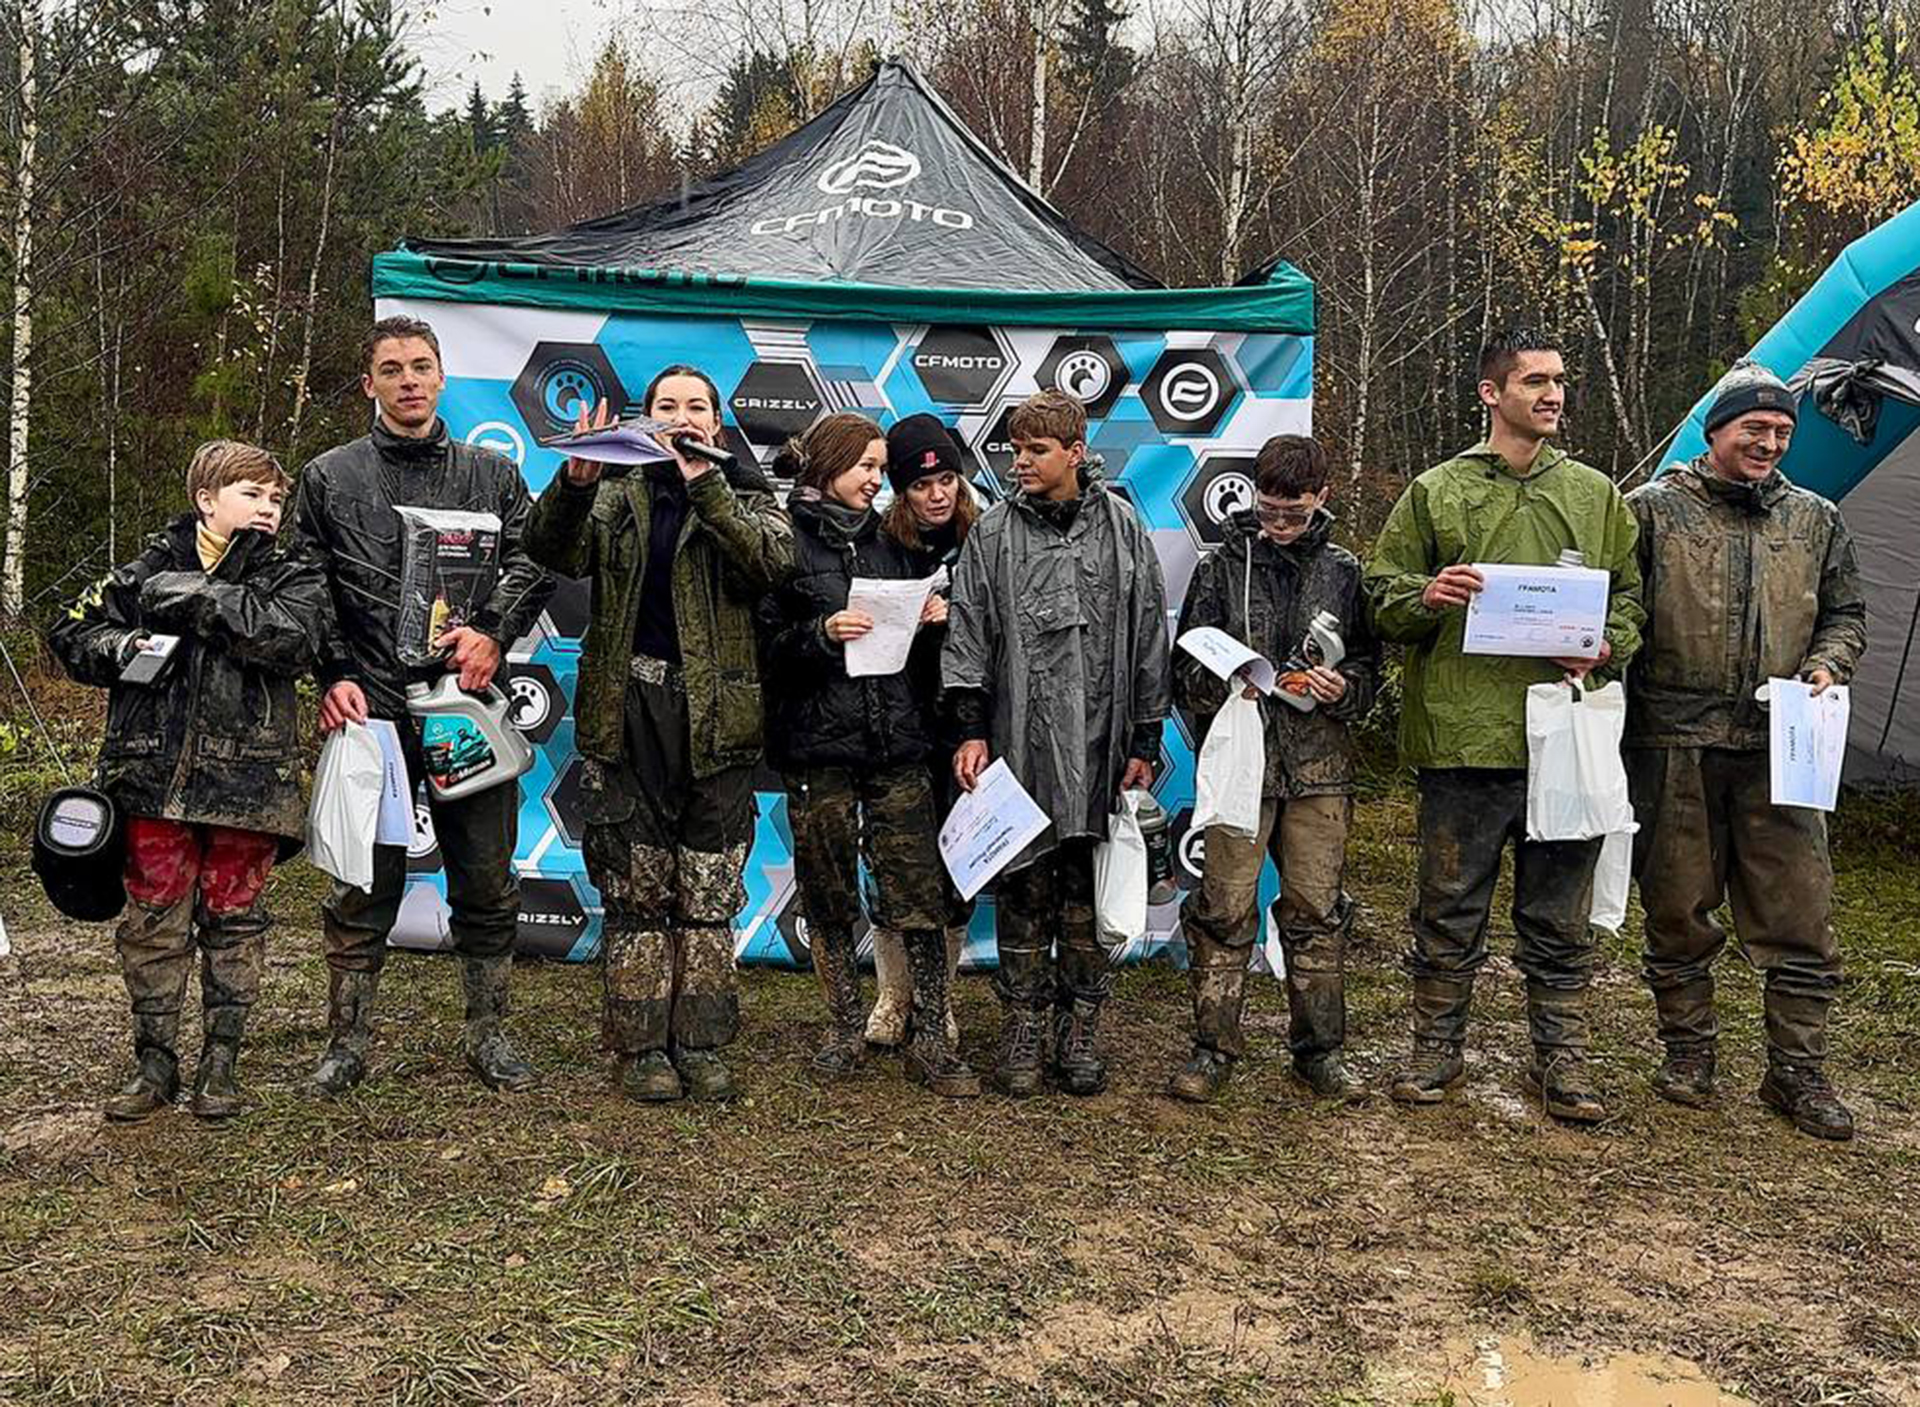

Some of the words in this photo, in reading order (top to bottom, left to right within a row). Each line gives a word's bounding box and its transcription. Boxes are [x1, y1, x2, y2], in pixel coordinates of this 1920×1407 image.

[751, 198, 973, 235] CFMOTO
[914, 354, 1001, 369] CFMOTO
[734, 397, 818, 411] GRIZZLY
[1517, 584, 1557, 593] ГРАМОТА
[516, 912, 583, 926] RIZZLY
